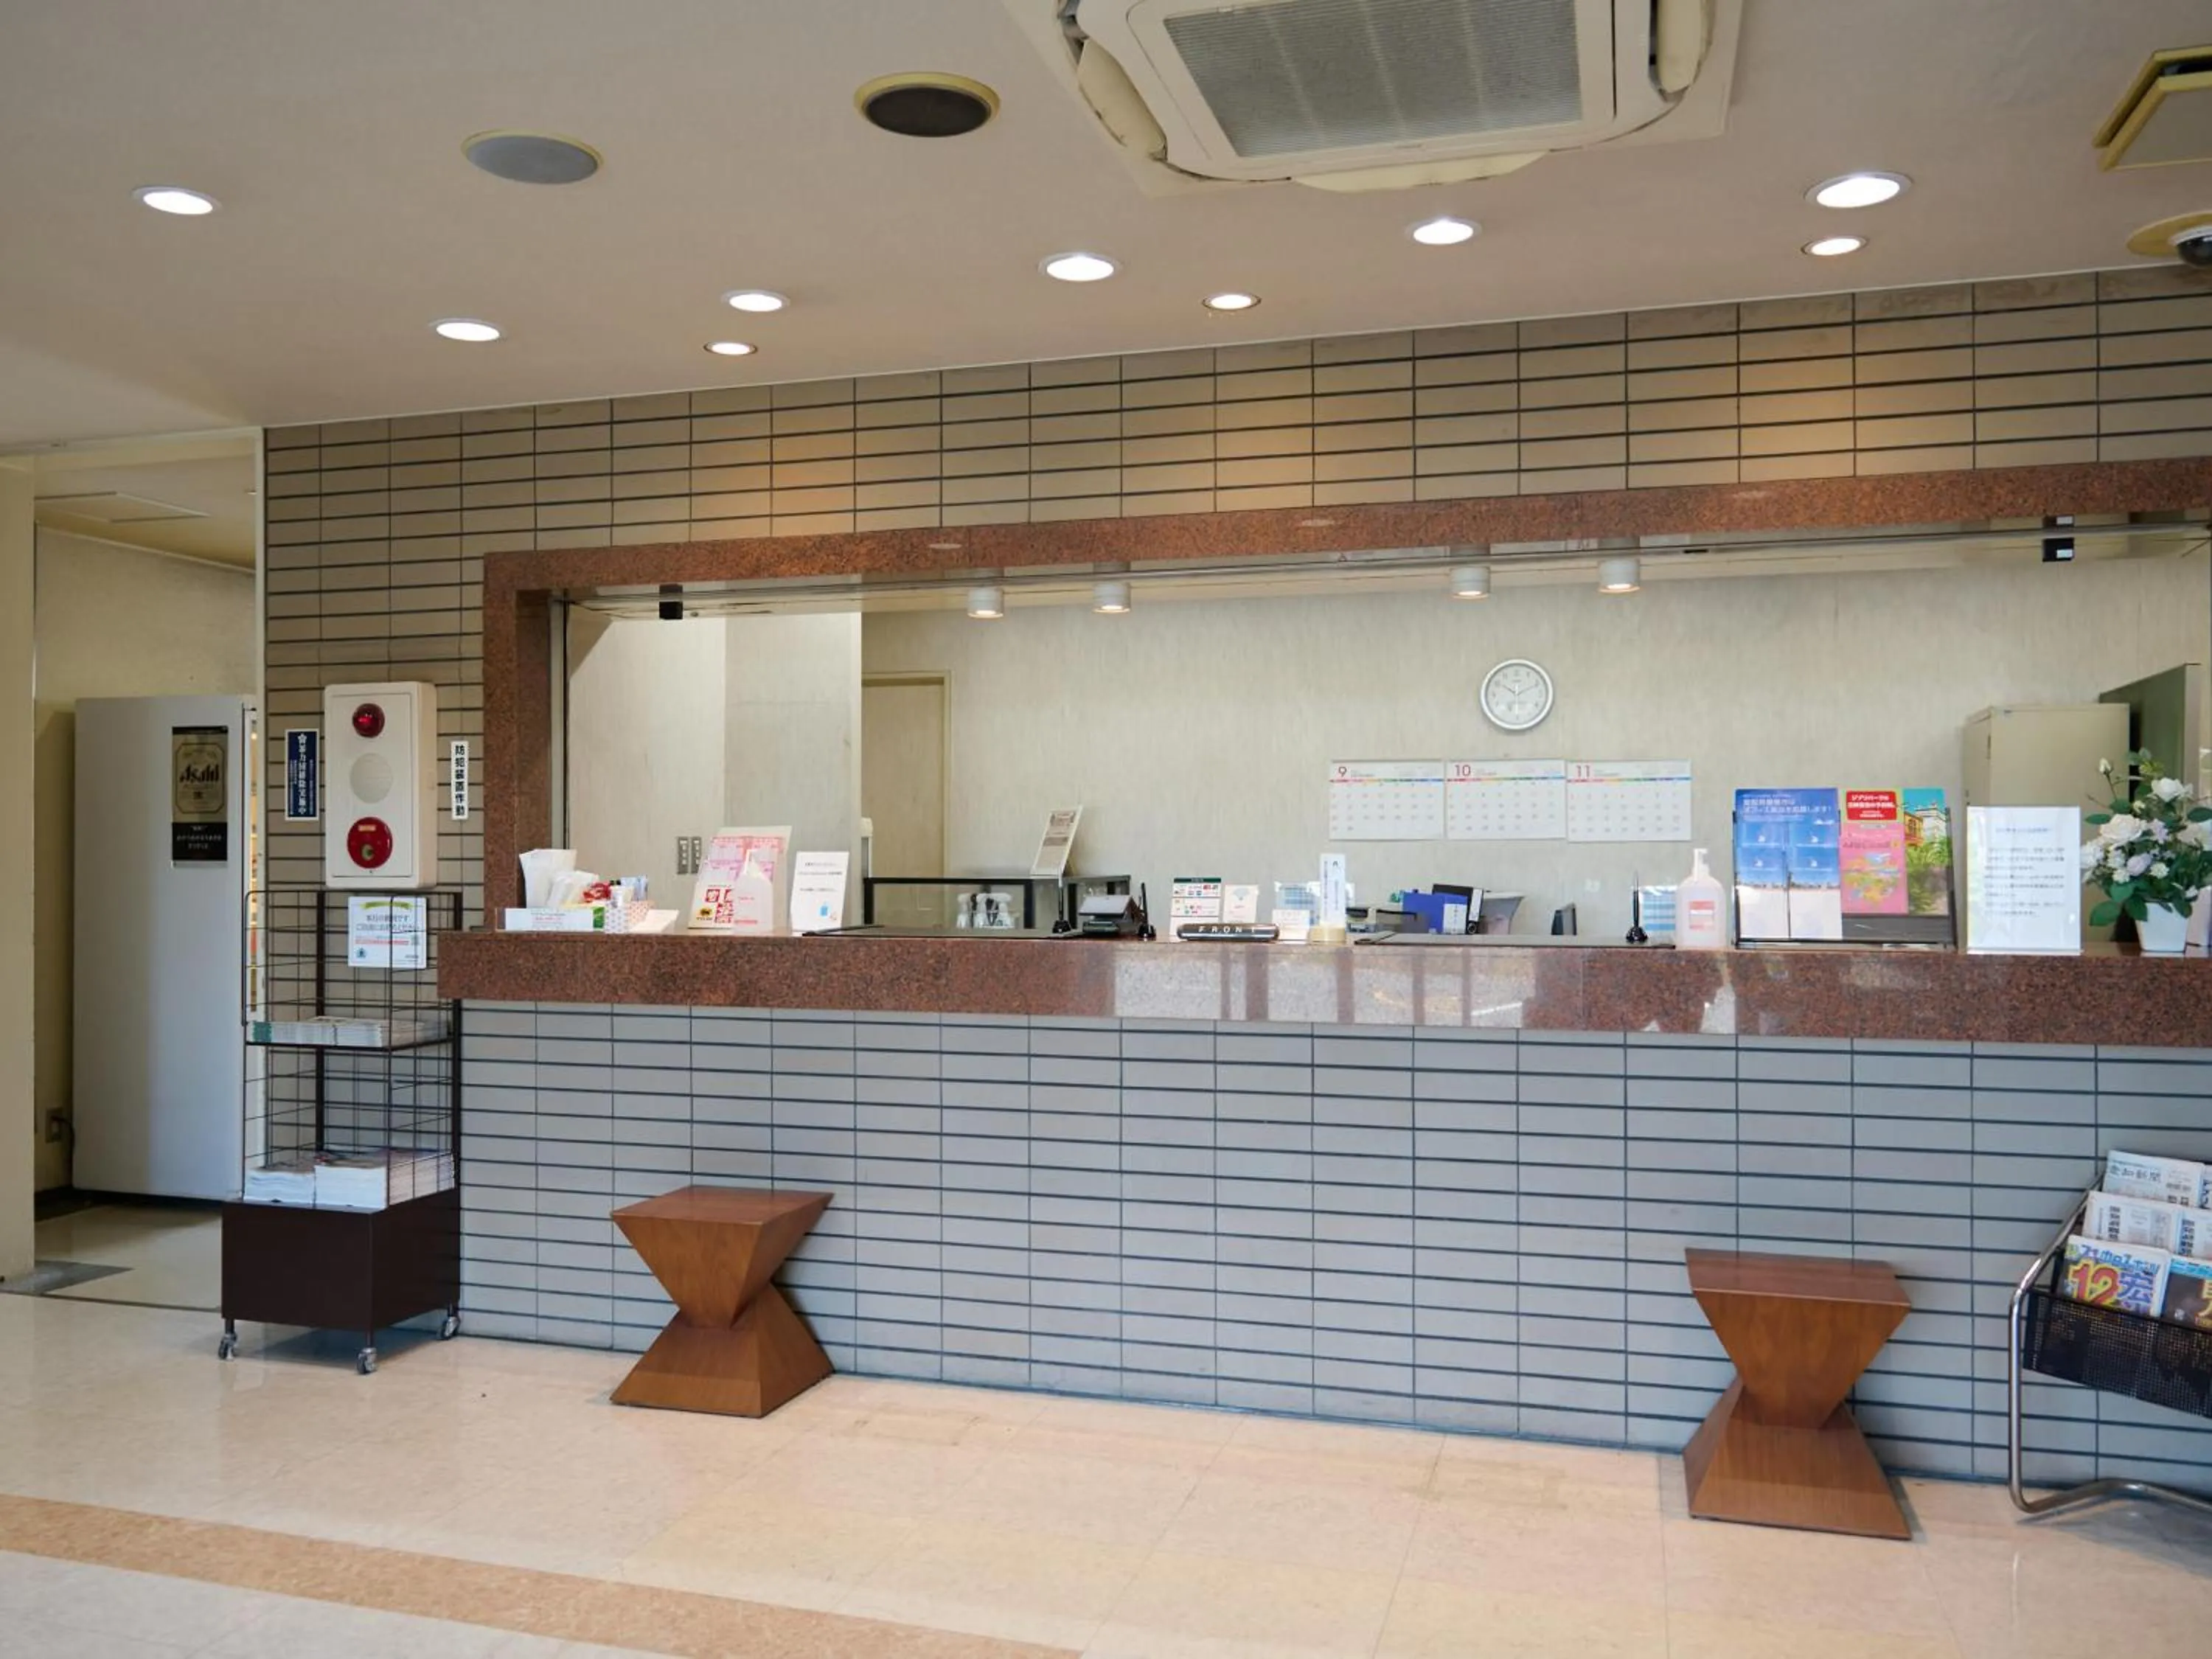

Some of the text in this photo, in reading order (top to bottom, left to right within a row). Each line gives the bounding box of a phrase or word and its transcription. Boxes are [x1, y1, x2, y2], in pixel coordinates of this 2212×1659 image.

[179, 762, 220, 783] Asahi
[1338, 766, 1347, 777] 9
[1455, 765, 1471, 776] 10
[1576, 765, 1590, 777] 11
[1198, 925, 1256, 933] FRONT
[2070, 1259, 2119, 1306] 12
